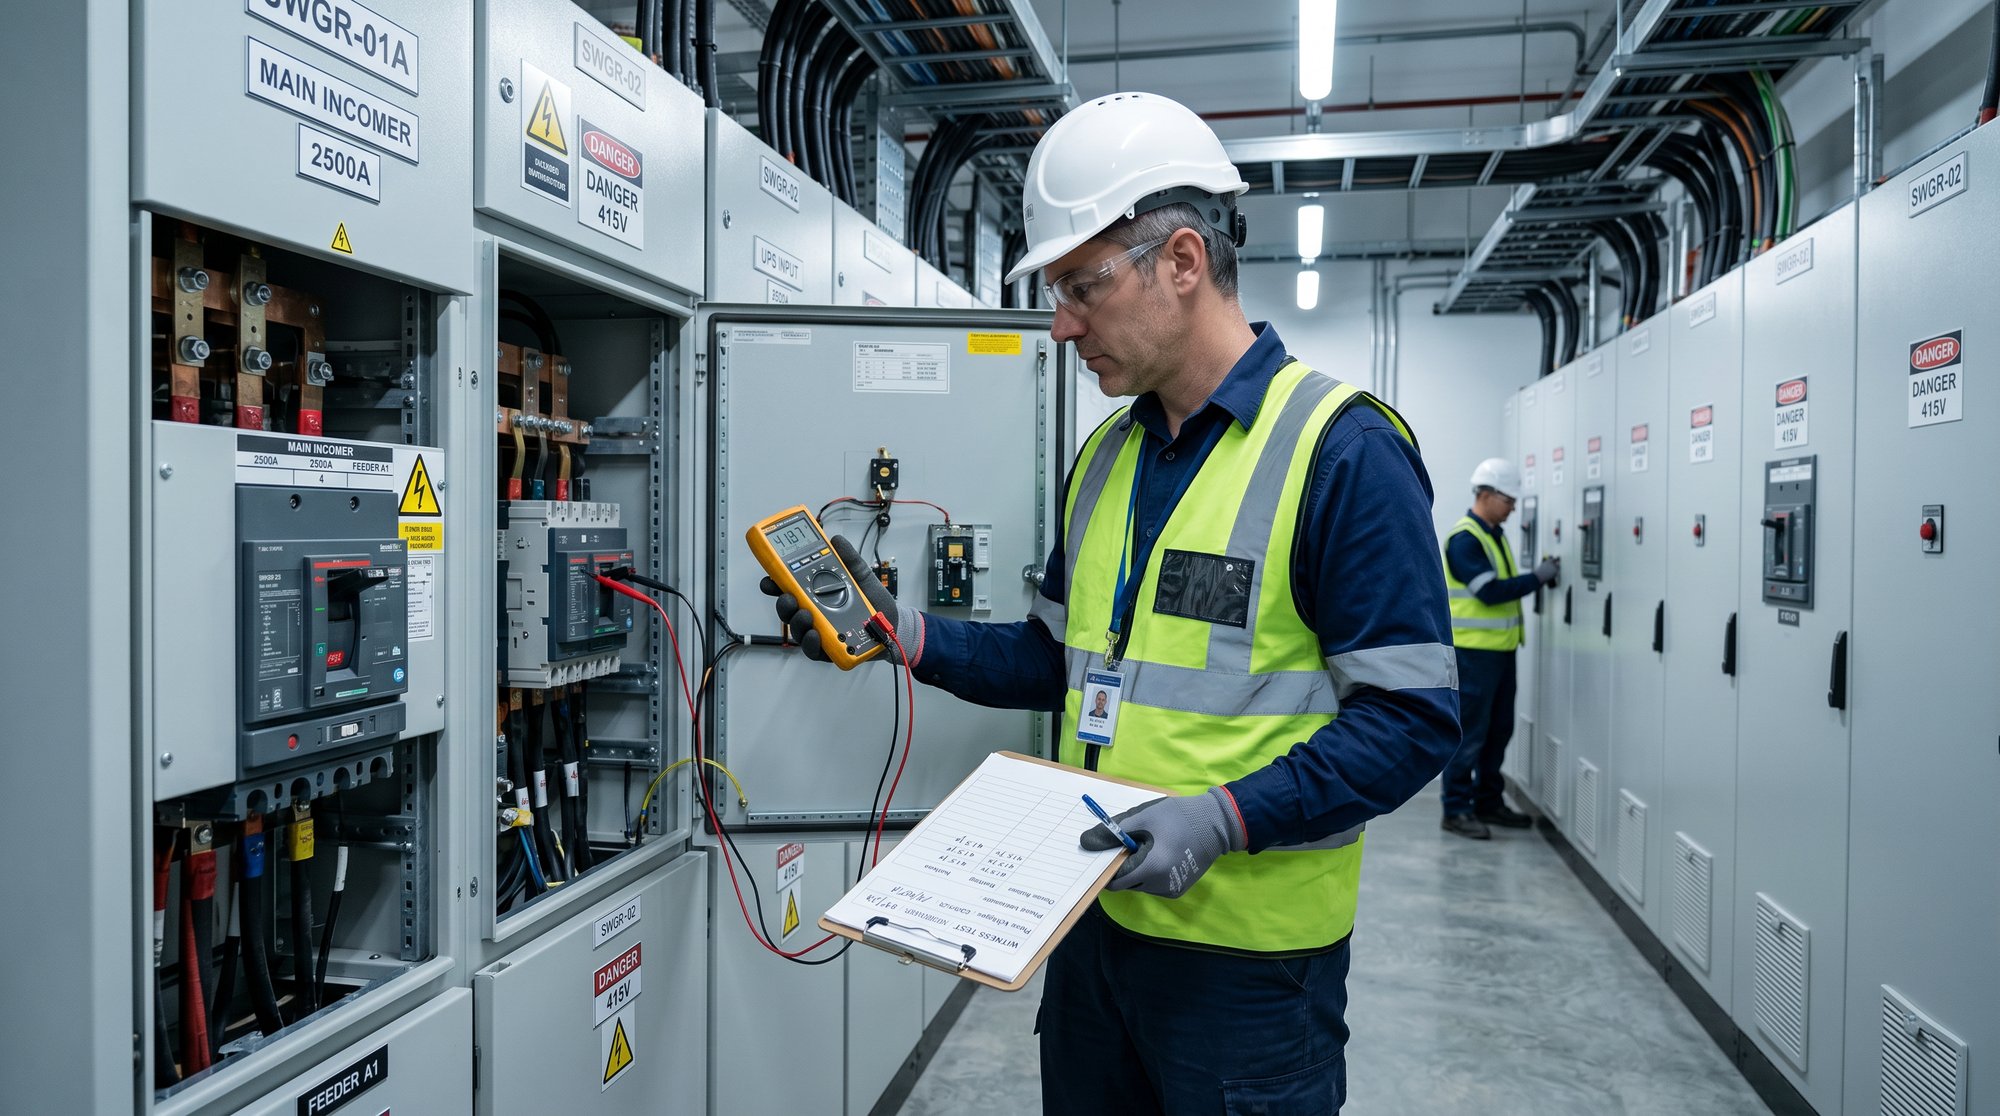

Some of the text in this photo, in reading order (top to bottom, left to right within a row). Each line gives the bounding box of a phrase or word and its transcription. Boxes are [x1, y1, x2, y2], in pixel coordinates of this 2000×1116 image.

[264, 0, 410, 76] WGR-01A
[582, 39, 641, 97] SWGR-02
[260, 57, 412, 148] MAIN INCOMER
[311, 142, 371, 186] 2500A
[590, 134, 635, 176] DANGER
[586, 168, 639, 214] DANGER
[763, 165, 799, 203] SWGR-02
[1911, 163, 1962, 207] SWGR-02
[597, 203, 628, 234] 415V
[761, 247, 799, 280] UPS INPUT
[1915, 341, 1954, 366] DANGER
[1912, 372, 1957, 398] DANGER
[1921, 397, 1946, 418] 415V
[254, 455, 390, 473] 2500A 2500A FEEDER A1
[287, 440, 354, 457] MAIN INCOMER
[318, 474, 325, 484] 4
[784, 860, 799, 881] 415V
[601, 904, 636, 937] SWGR-02
[953, 924, 1019, 949] WITNESS TEST
[598, 949, 639, 990] DANGER
[606, 978, 631, 1010] 415V
[308, 1059, 378, 1116] FEEDER A1
